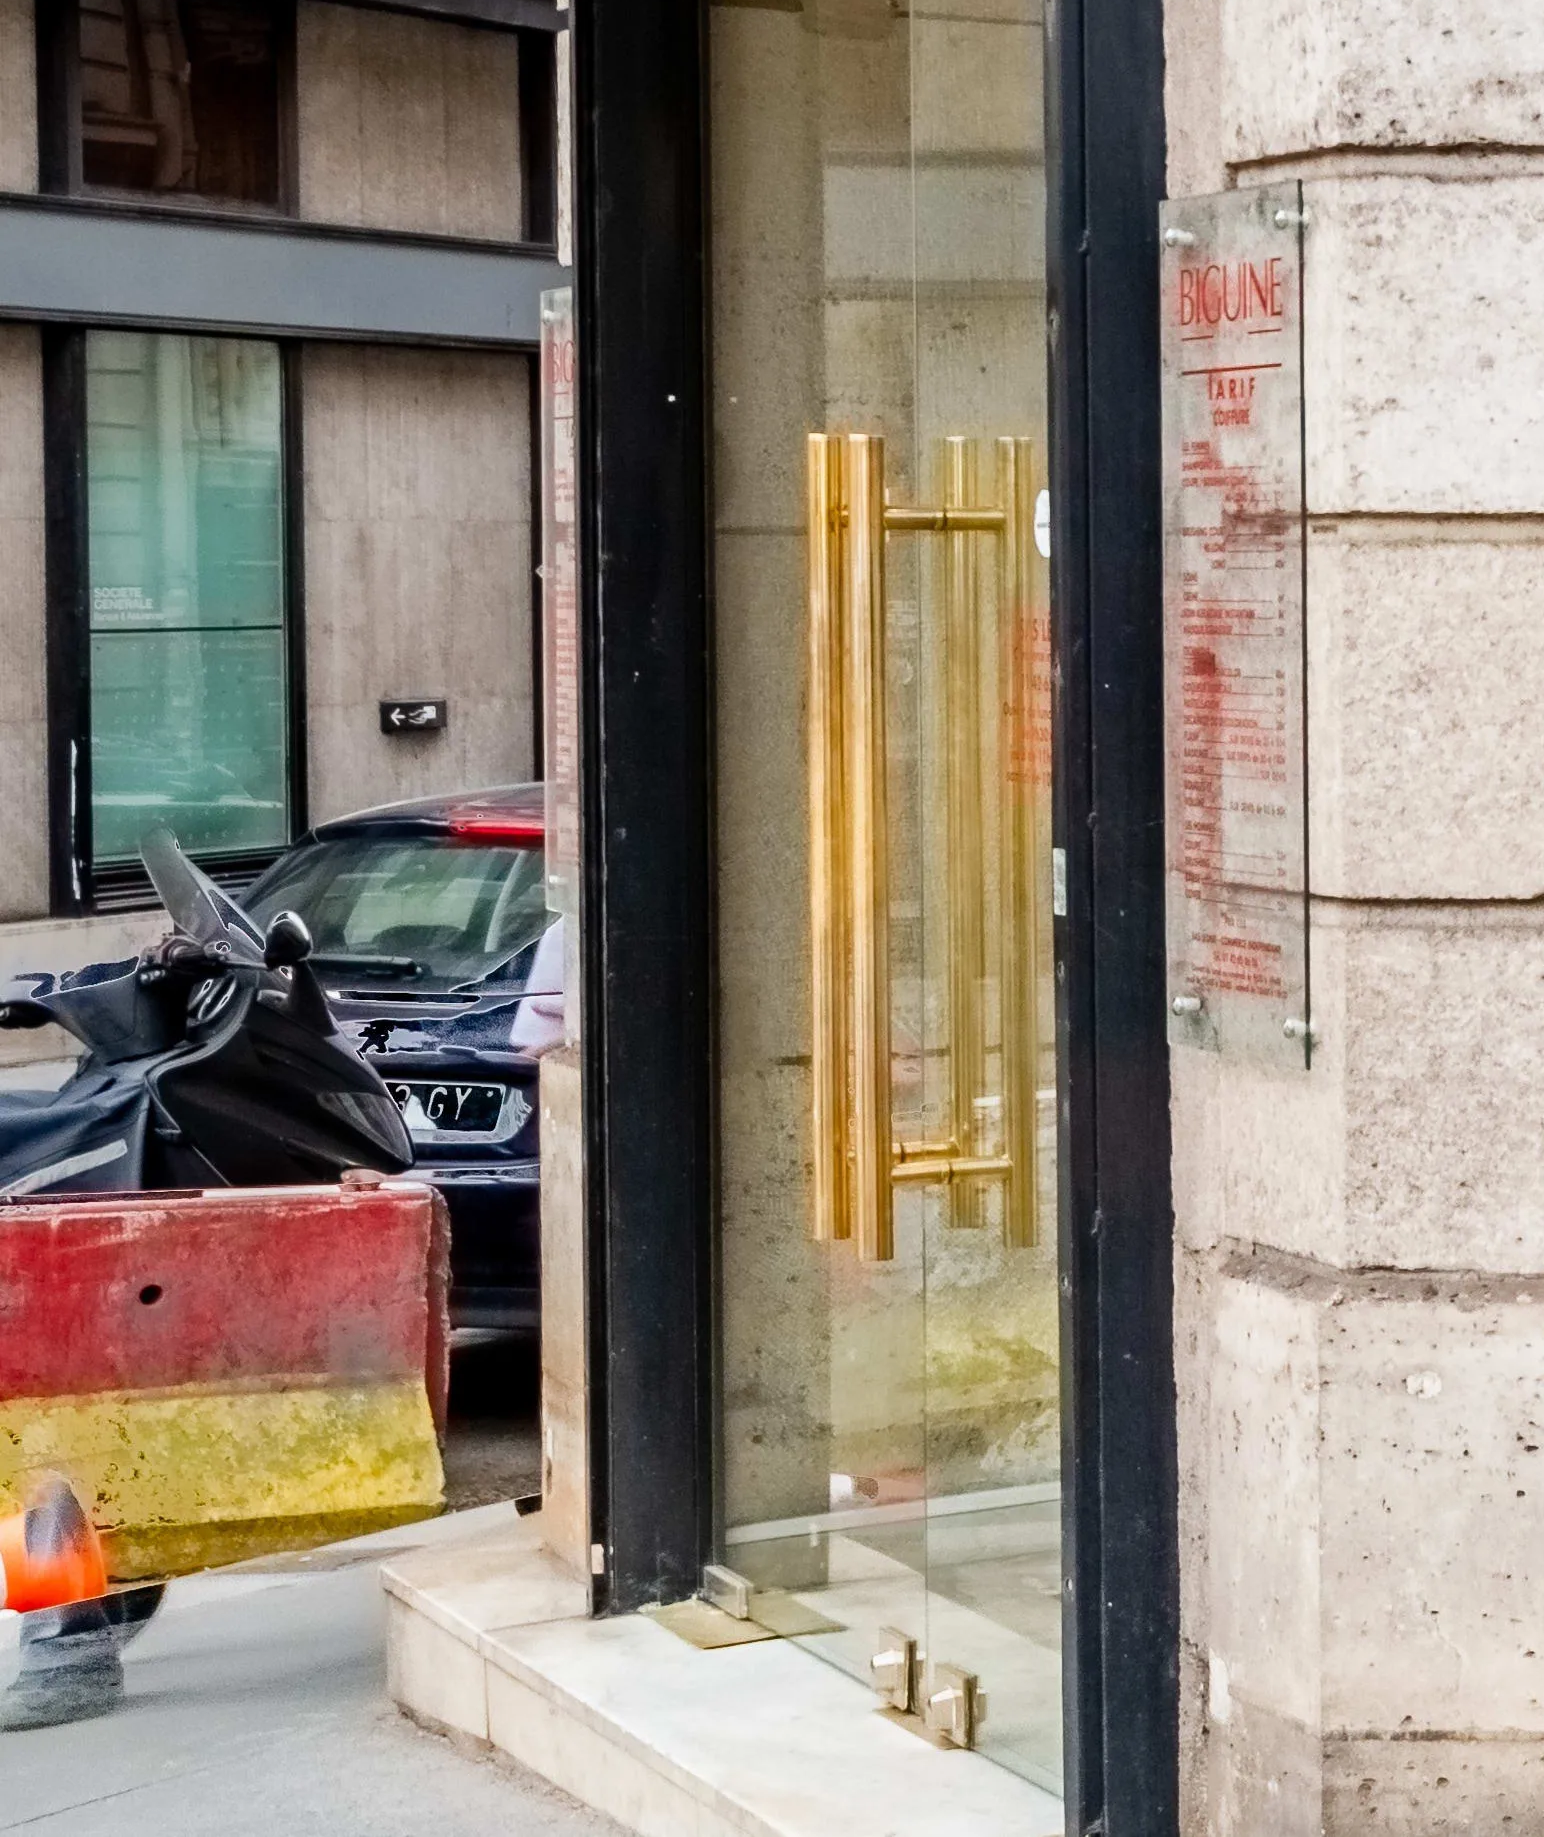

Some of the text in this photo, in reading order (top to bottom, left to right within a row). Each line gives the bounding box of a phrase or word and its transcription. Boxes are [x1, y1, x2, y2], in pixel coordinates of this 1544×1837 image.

[1178, 257, 1284, 326] BIGUINE
[1207, 372, 1256, 401] TARIF
[426, 1086, 473, 1121] GY
